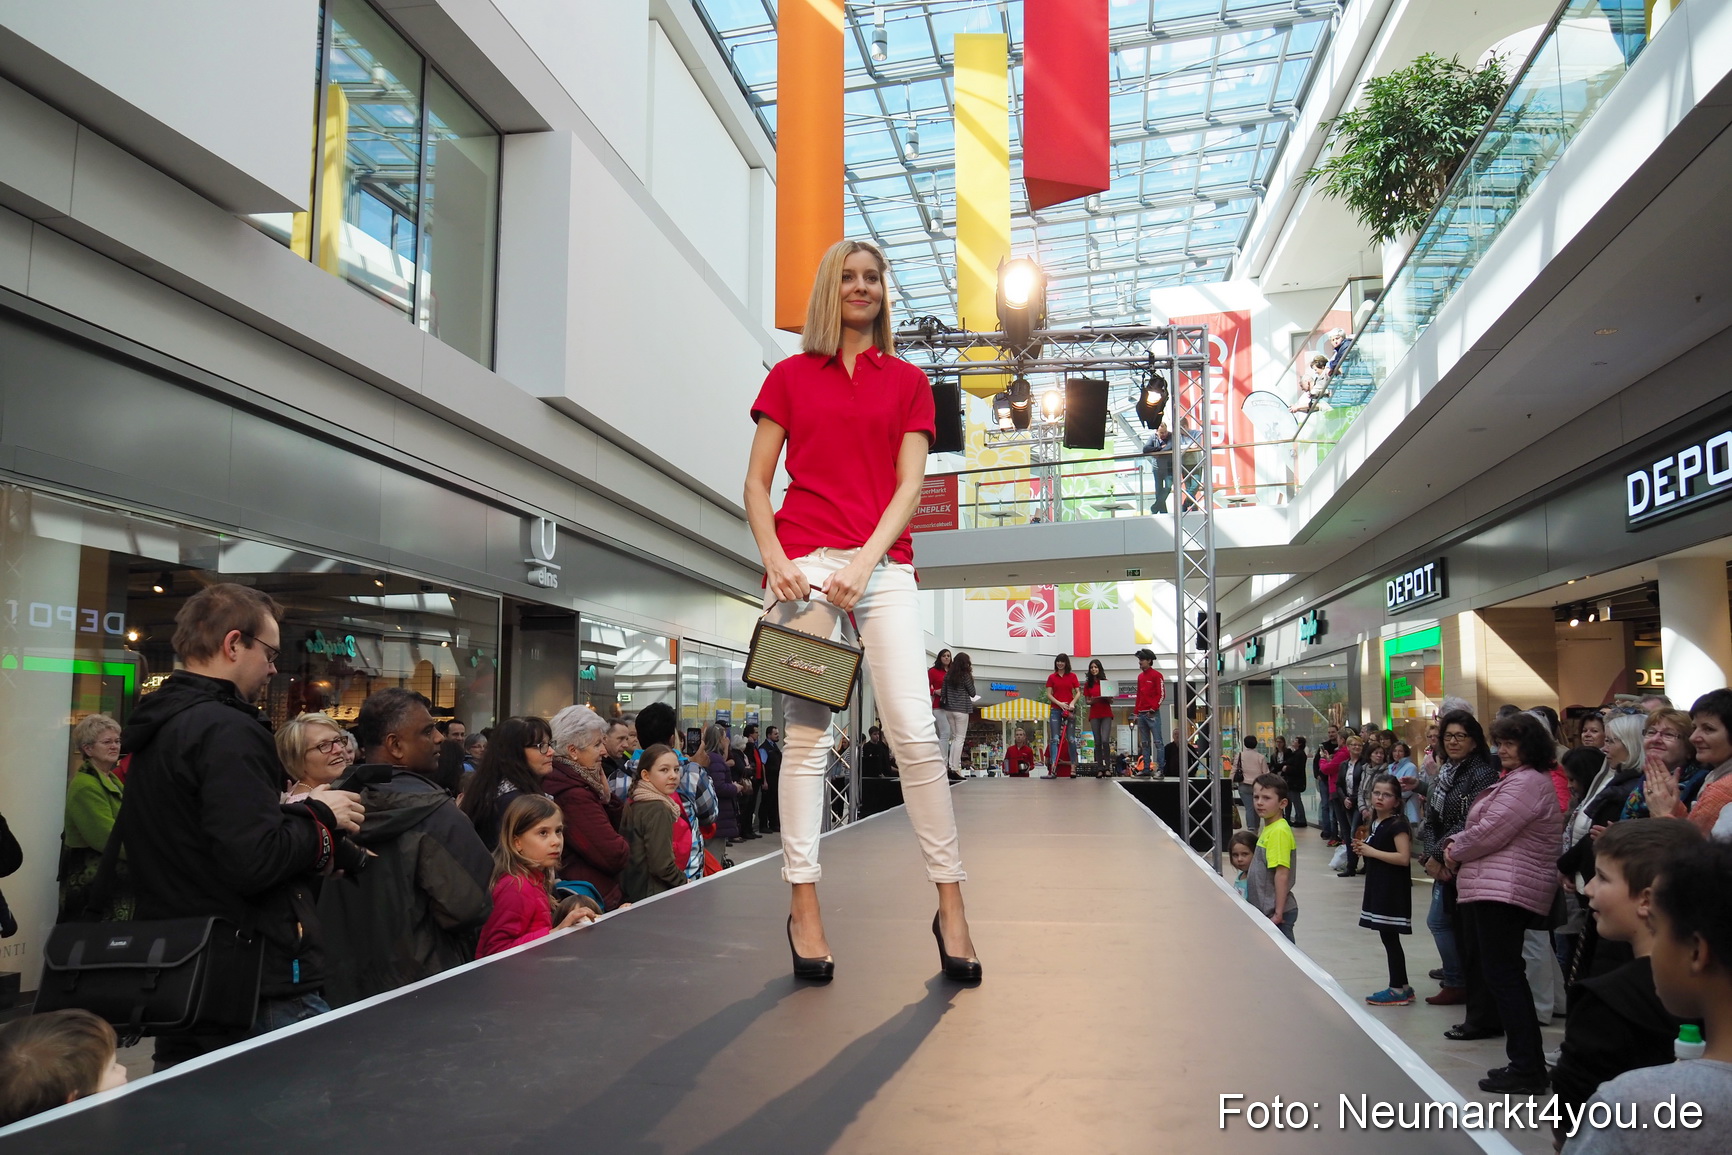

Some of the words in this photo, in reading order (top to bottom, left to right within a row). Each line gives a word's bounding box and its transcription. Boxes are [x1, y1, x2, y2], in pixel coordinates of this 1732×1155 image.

[1626, 430, 1732, 517] DEPO
[540, 516, 556, 561] U
[1386, 562, 1434, 608] DEPOT
[0, 942, 26, 958] NTI
